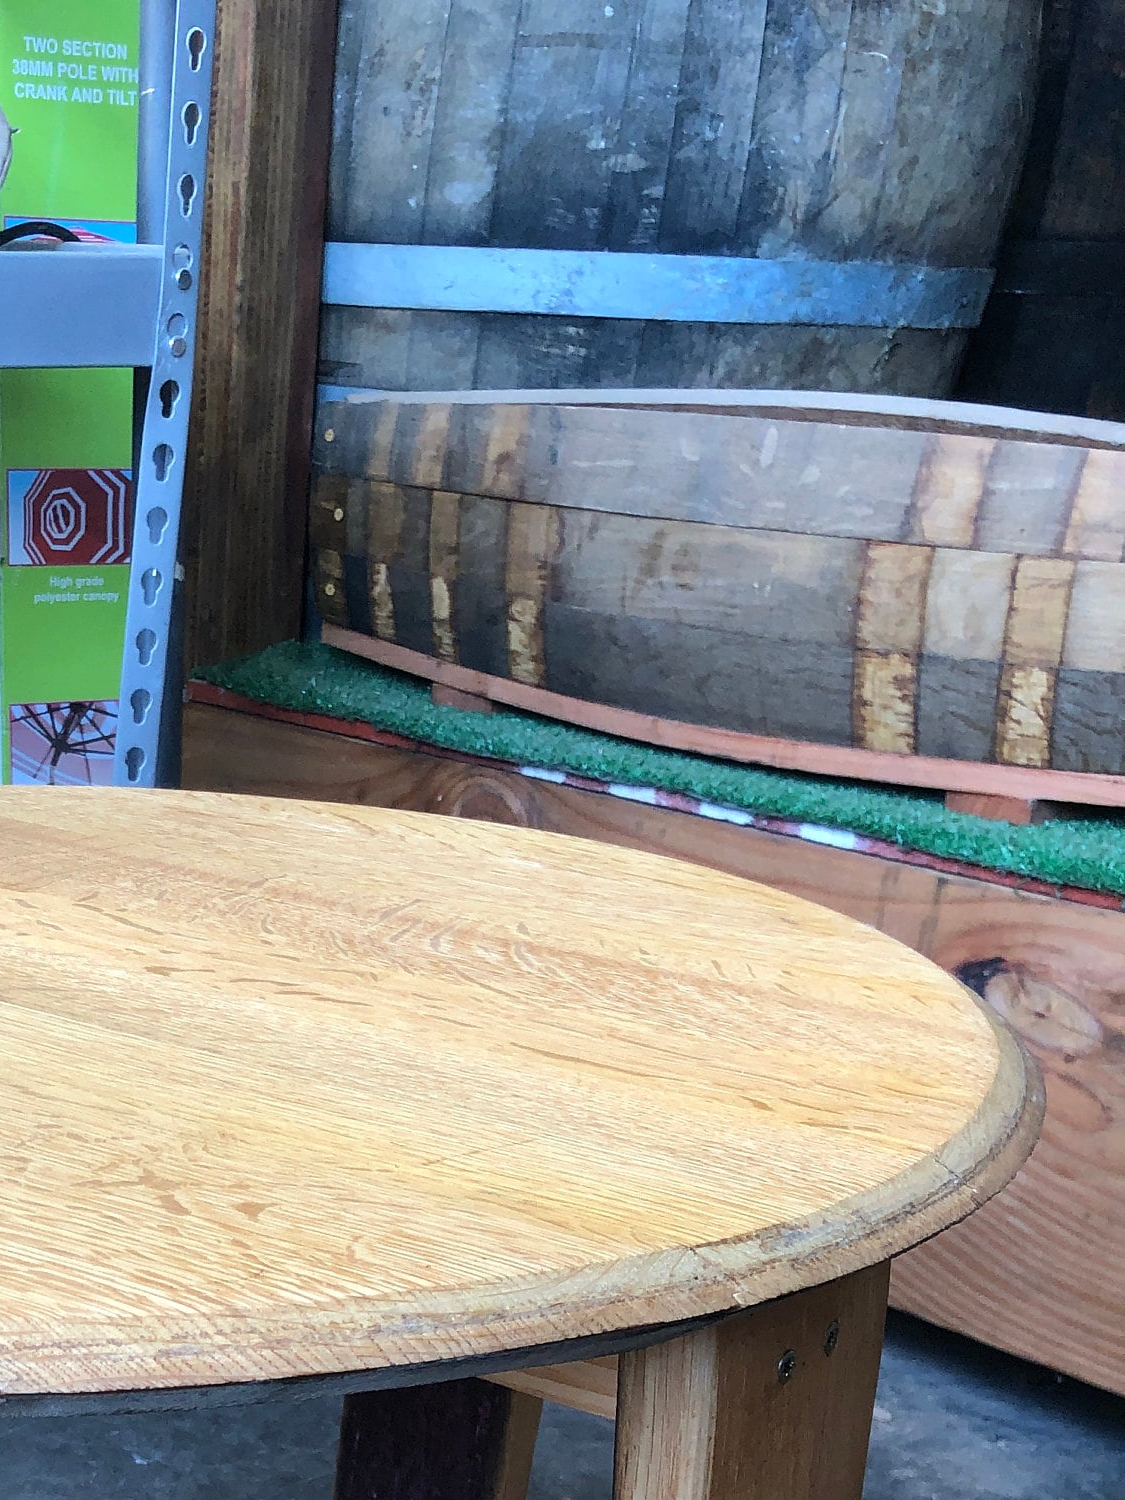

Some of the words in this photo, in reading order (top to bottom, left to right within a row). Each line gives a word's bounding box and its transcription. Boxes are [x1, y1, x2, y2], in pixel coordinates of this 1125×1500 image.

[23, 36, 58, 54] TWO
[62, 39, 127, 60] SECTION
[12, 58, 53, 77] 38MM
[57, 62, 97, 80] POLE
[101, 65, 139, 83] WITH
[14, 82, 68, 101] CRANK
[71, 86, 103, 104] AND
[107, 89, 137, 106] TILT
[50, 576, 73, 589] High
[75, 576, 104, 588] grade
[34, 592, 80, 604] polyester
[83, 592, 119, 603] canopy
